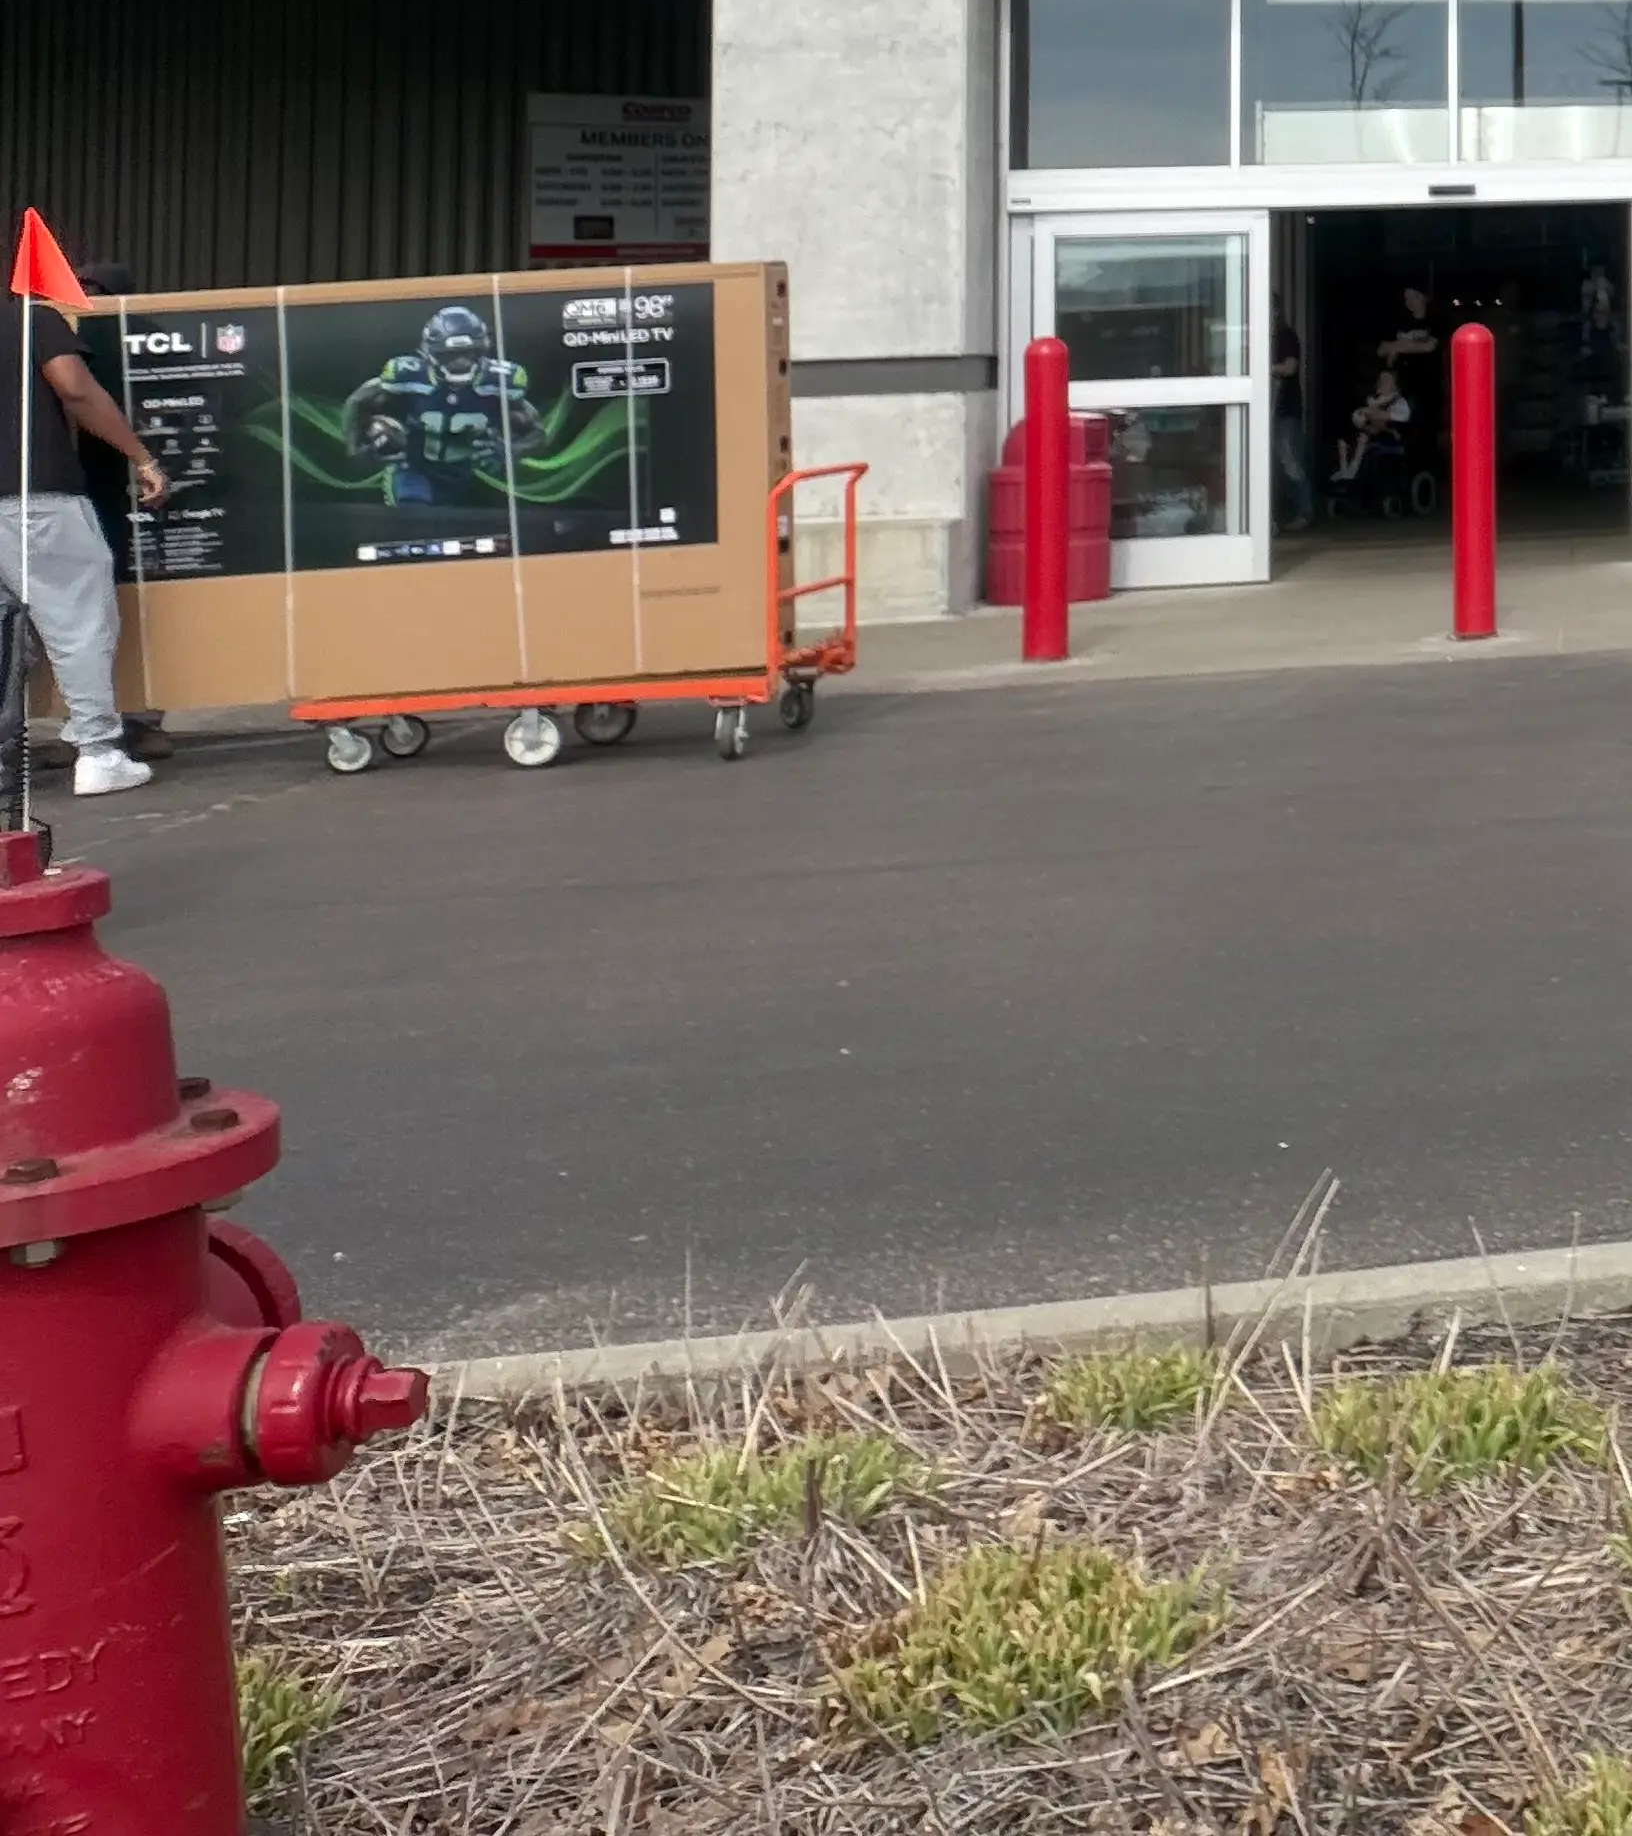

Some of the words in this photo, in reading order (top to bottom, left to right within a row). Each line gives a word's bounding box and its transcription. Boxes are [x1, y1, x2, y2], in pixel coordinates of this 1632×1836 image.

[580, 130, 677, 148] MEMBERS
[681, 134, 710, 148] ON
[124, 332, 193, 354] TCL
[651, 327, 675, 341] TV
[0, 1639, 106, 1701] EDY
